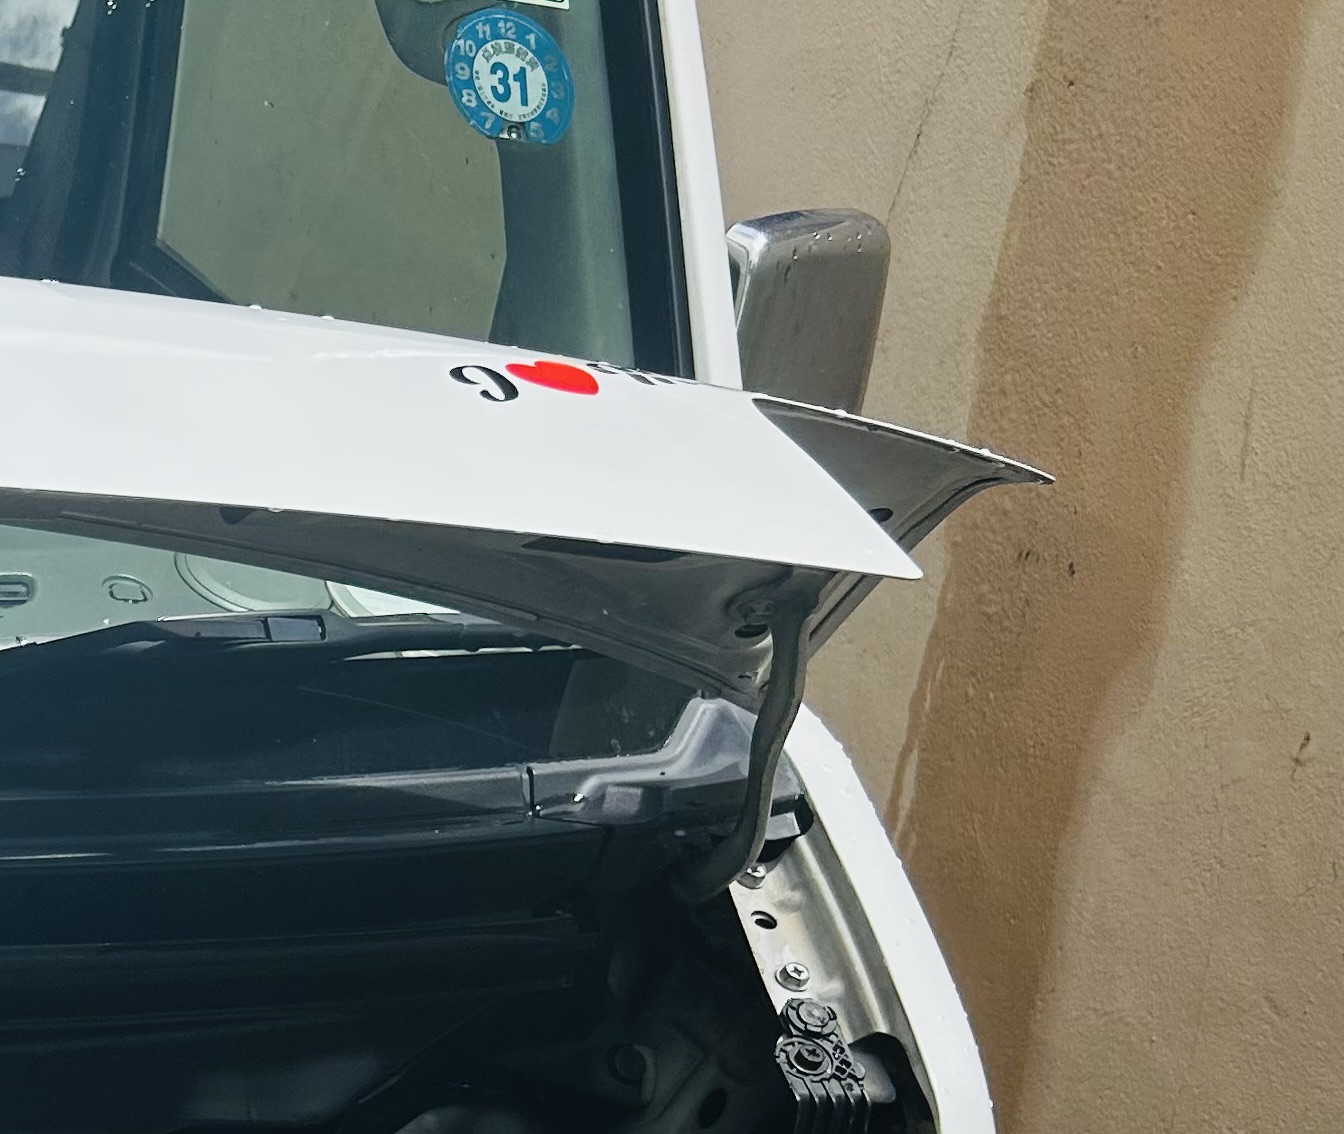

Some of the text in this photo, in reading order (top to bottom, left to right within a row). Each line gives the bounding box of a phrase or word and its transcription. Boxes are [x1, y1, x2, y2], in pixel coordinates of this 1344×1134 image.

[476, 19, 538, 50] 11 12 1
[456, 37, 477, 58] 10
[455, 62, 469, 80] 9
[544, 54, 558, 72] 2
[490, 60, 529, 107] 31
[461, 88, 477, 108] 8
[480, 111, 496, 129] 7
